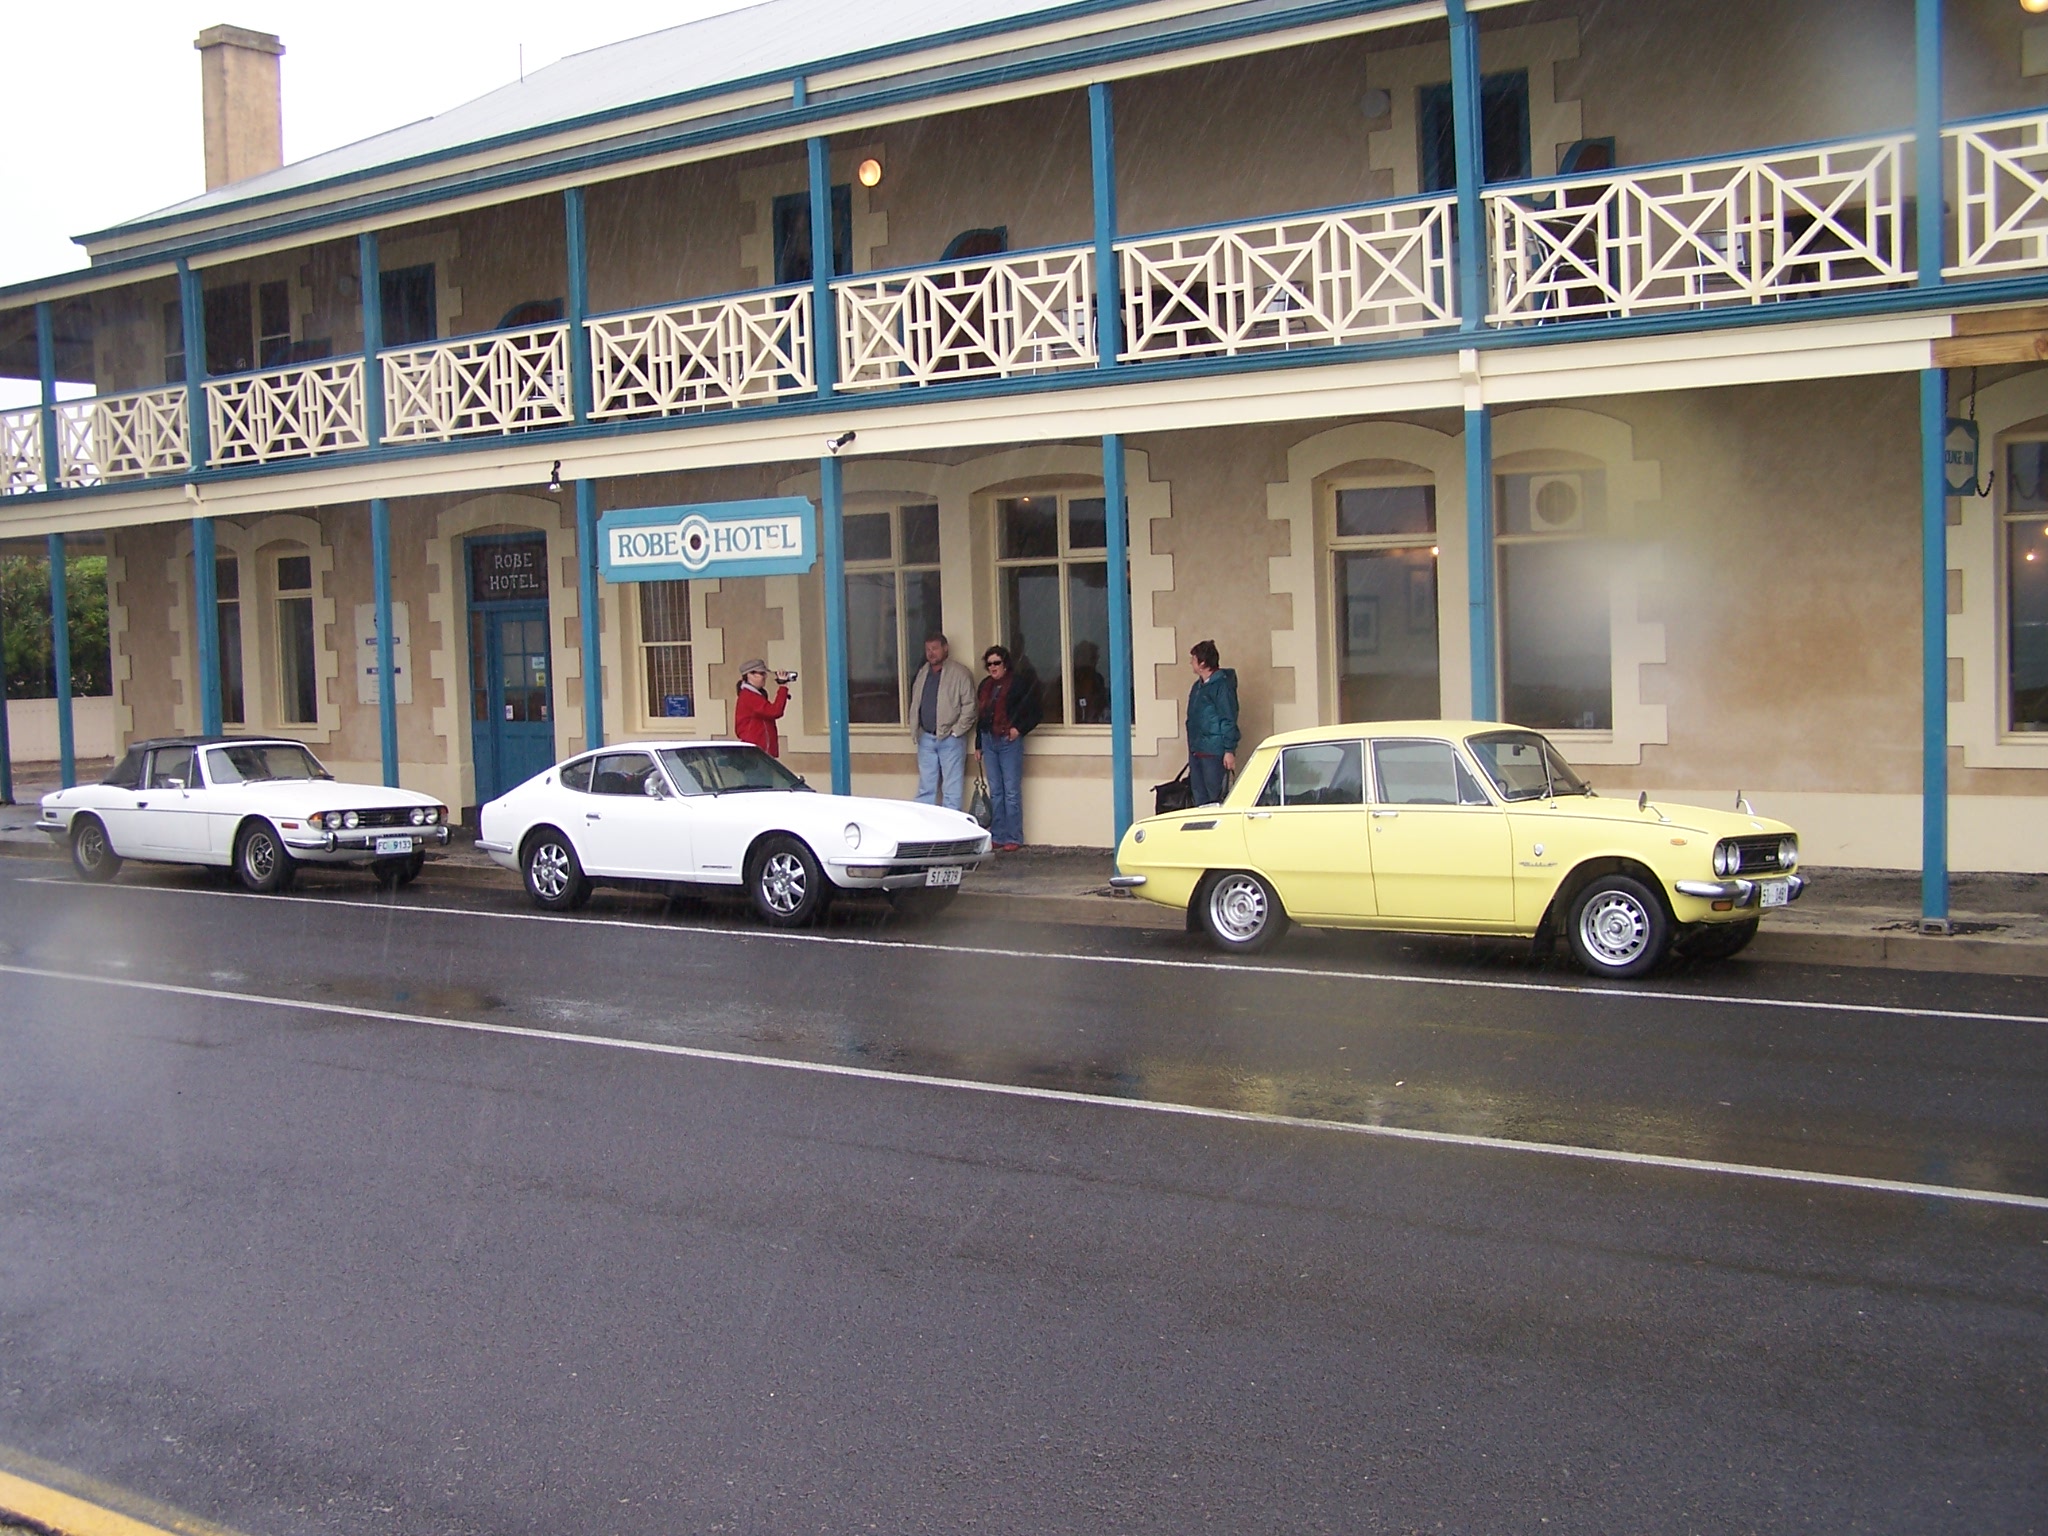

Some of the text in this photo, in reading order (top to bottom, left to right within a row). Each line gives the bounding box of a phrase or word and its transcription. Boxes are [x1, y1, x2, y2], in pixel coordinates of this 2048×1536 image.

[618, 532, 679, 558] ROBE
[714, 524, 796, 553] HOTEL
[494, 552, 533, 569] ROBE
[489, 573, 539, 590] HOTEL
